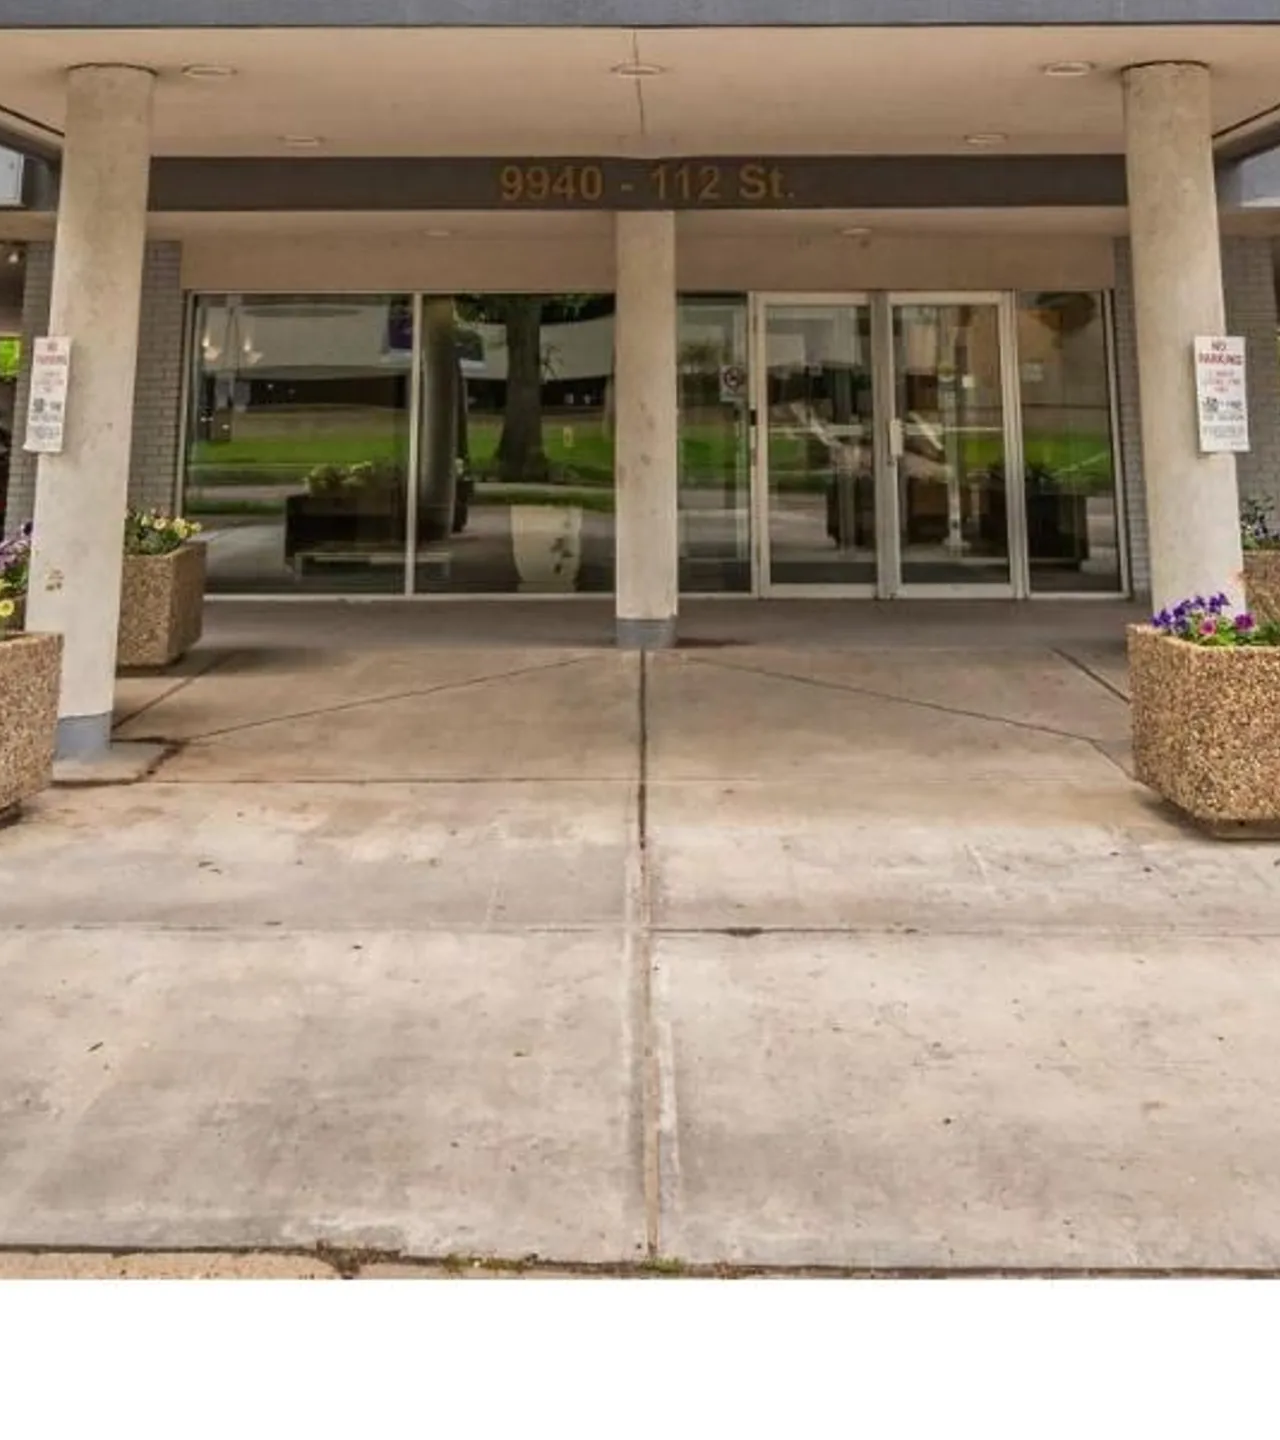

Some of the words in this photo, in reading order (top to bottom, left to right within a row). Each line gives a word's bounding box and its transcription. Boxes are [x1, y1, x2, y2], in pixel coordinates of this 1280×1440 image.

[499, 164, 604, 201] 9940
[651, 164, 721, 201] 112
[738, 163, 796, 200] St.
